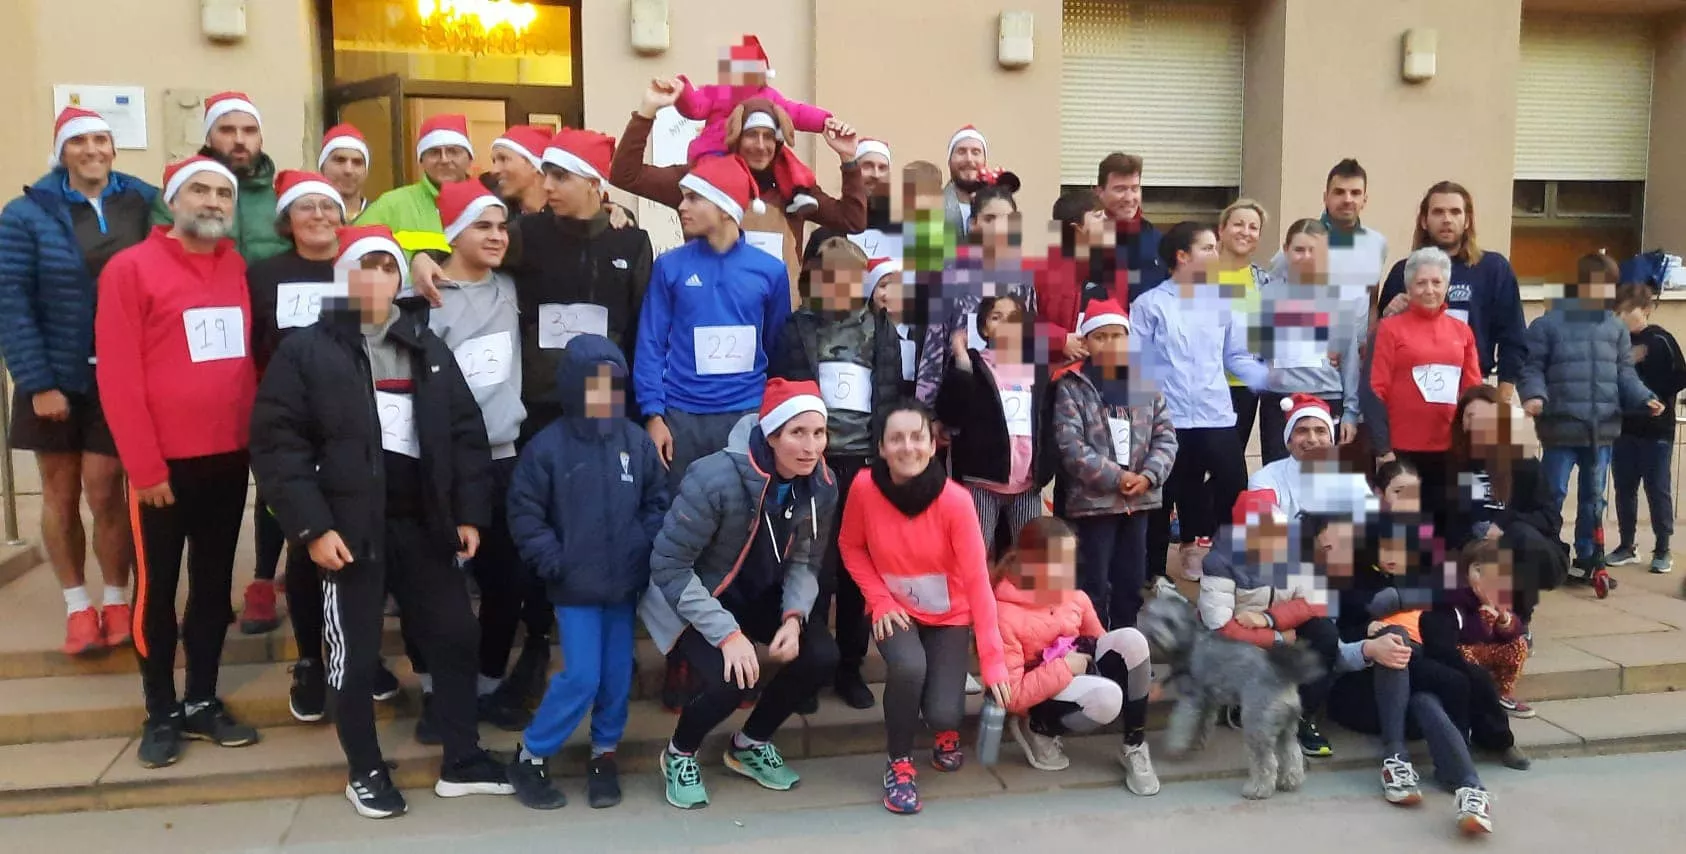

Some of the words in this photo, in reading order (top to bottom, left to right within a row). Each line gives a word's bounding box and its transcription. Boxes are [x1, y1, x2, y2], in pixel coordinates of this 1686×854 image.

[194, 318, 229, 350] 19
[551, 311, 584, 337] 32
[707, 334, 742, 360] 22
[833, 371, 856, 400] 5
[1417, 370, 1446, 392] 13
[1004, 396, 1028, 423] 2
[1117, 427, 1129, 456] 3
